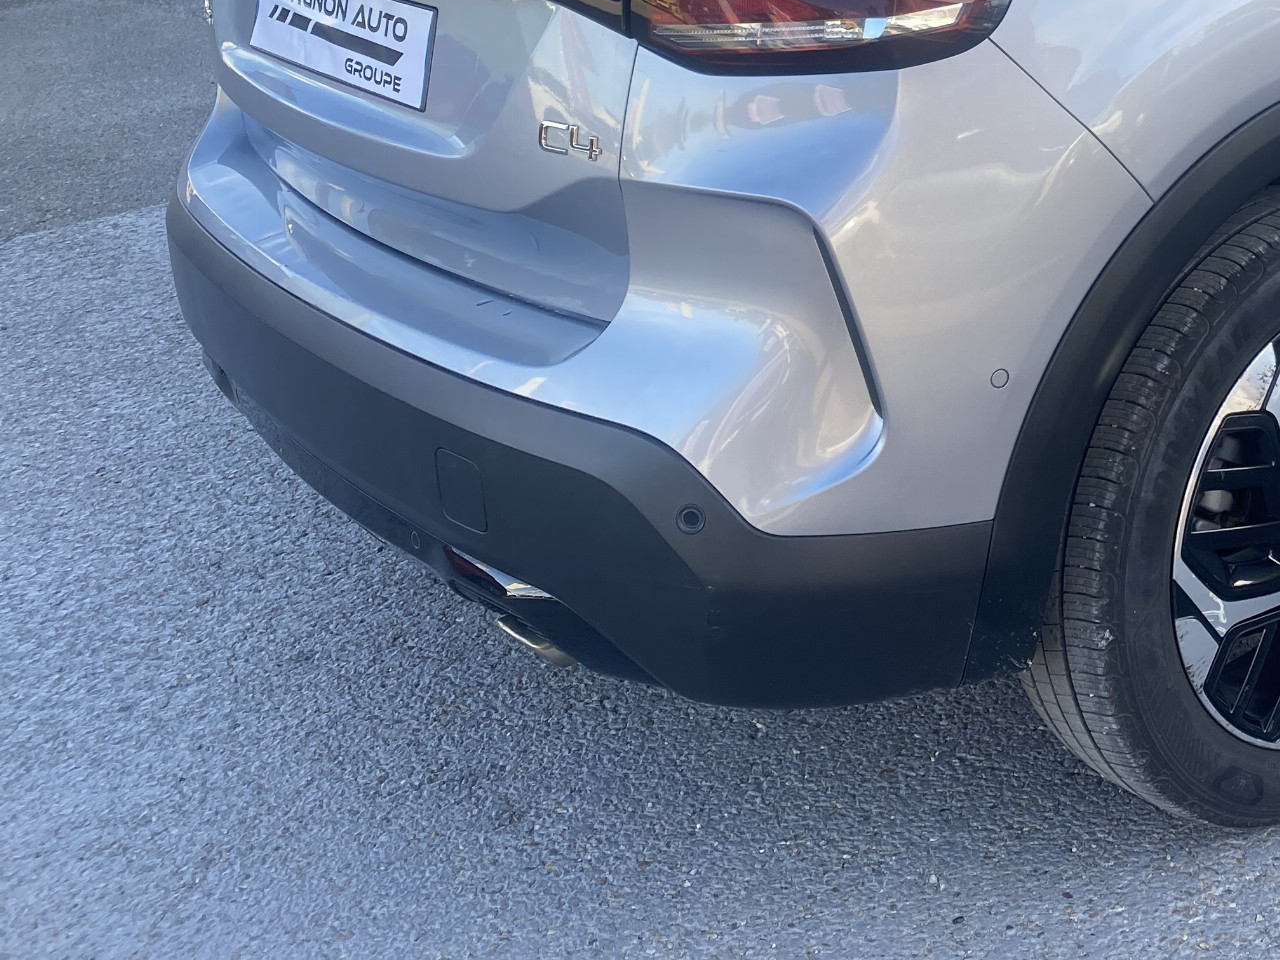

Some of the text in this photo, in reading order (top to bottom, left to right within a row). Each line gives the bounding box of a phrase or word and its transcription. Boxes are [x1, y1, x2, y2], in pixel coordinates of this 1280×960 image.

[351, 4, 408, 43] AUTO
[344, 57, 402, 93] GROUPE
[538, 120, 603, 161] C4
